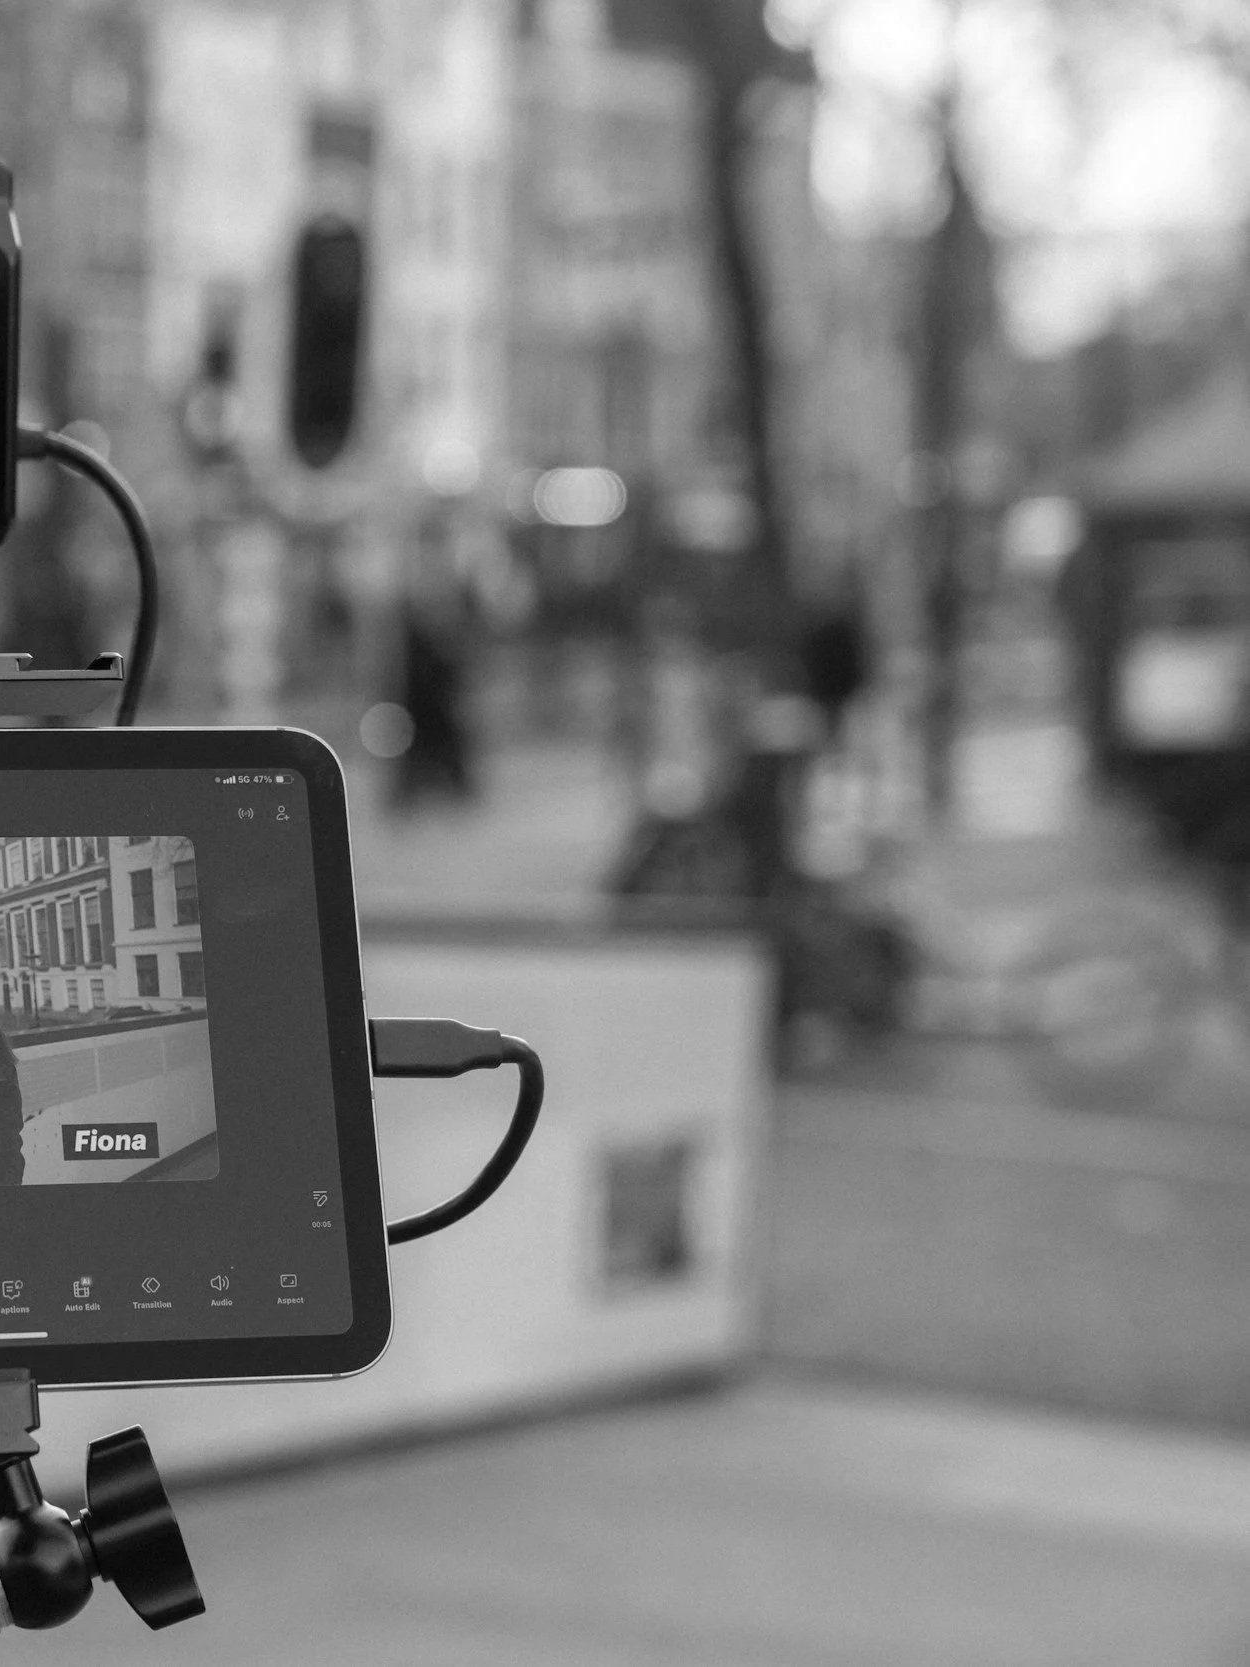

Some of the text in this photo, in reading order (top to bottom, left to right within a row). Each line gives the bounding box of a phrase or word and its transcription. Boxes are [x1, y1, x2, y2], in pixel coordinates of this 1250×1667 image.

[237, 775, 273, 784] 5G 47%
[74, 1128, 147, 1152] Fiona
[311, 1220, 332, 1229] 00:05
[132, 1300, 173, 1310] Transition
[210, 1298, 233, 1307] Audio
[276, 1297, 305, 1306] Aspect
[64, 1302, 101, 1312] Auto Edit
